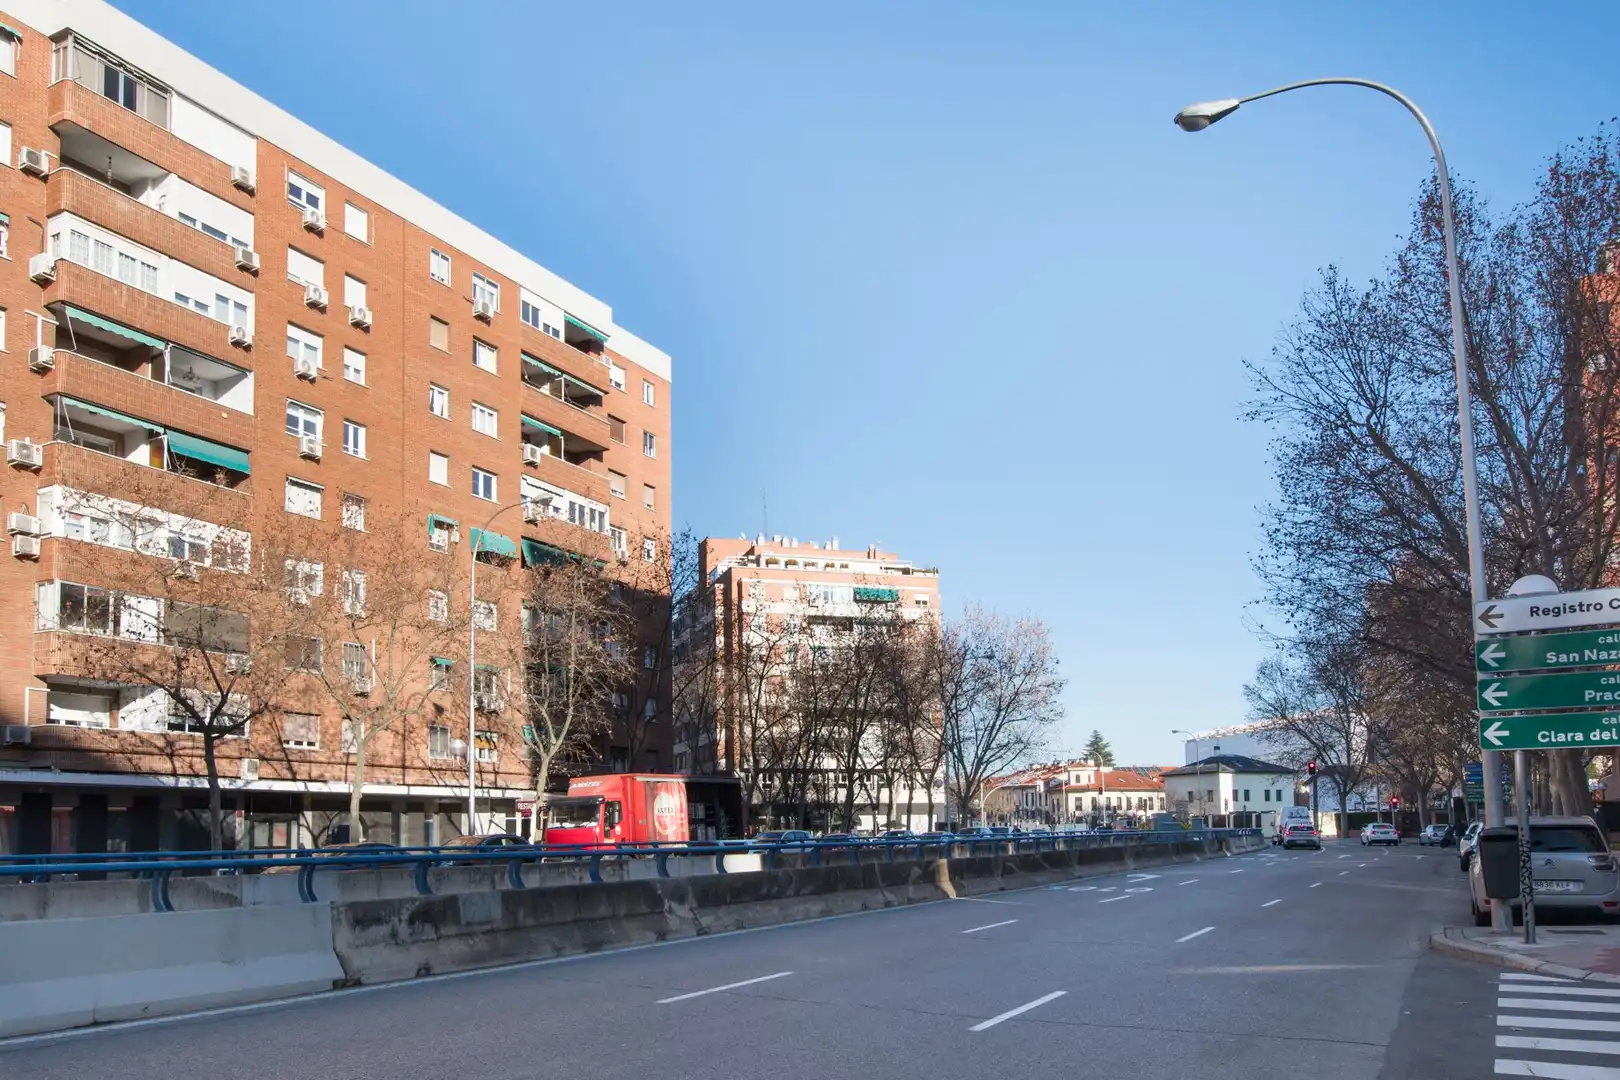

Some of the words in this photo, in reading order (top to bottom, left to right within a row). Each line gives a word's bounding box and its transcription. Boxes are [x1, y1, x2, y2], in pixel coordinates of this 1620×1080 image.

[1530, 602, 1603, 617] Registro
[1546, 652, 1579, 663] San
[1538, 731, 1584, 742] Clara
[1590, 728, 1618, 740] del
